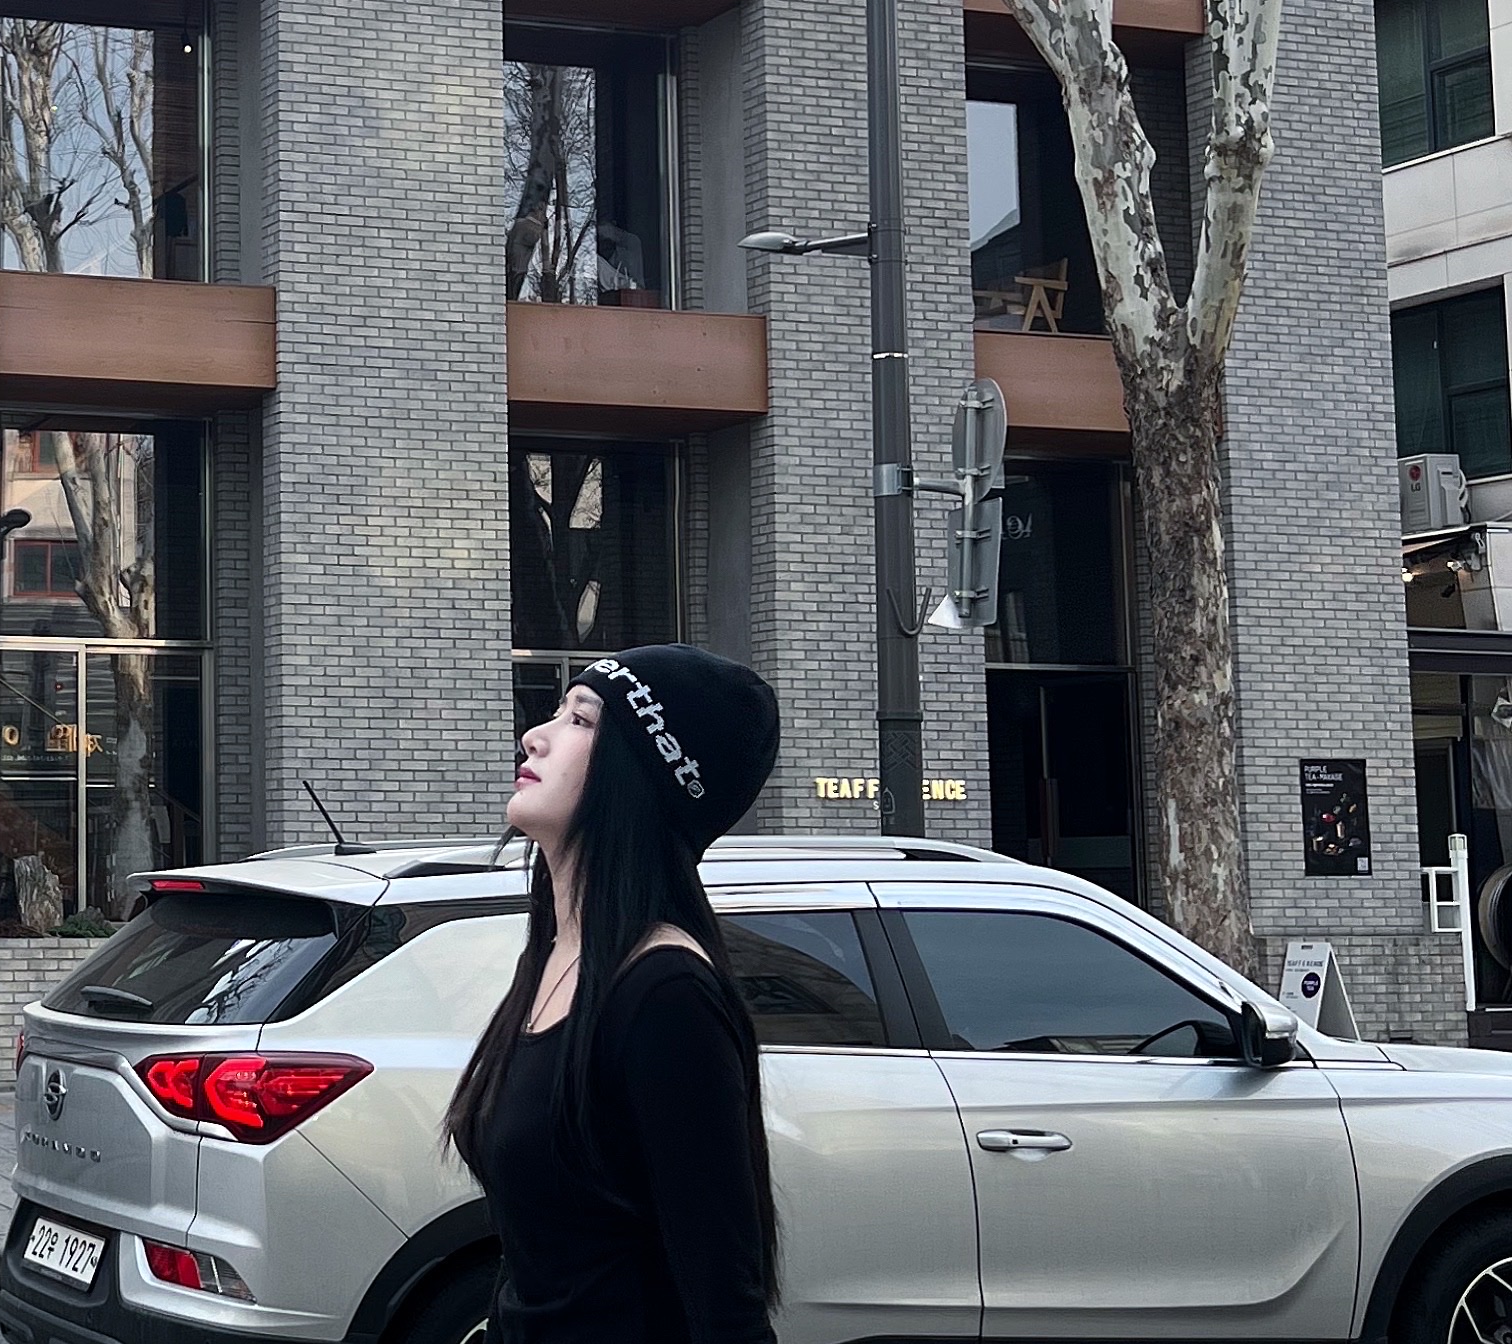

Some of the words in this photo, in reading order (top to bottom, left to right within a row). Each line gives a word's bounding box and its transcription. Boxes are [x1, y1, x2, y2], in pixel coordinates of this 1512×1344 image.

[1410, 482, 1421, 492] LG
[815, 776, 967, 800] TEAFFENCE
[59, 1234, 97, 1274] 1927
